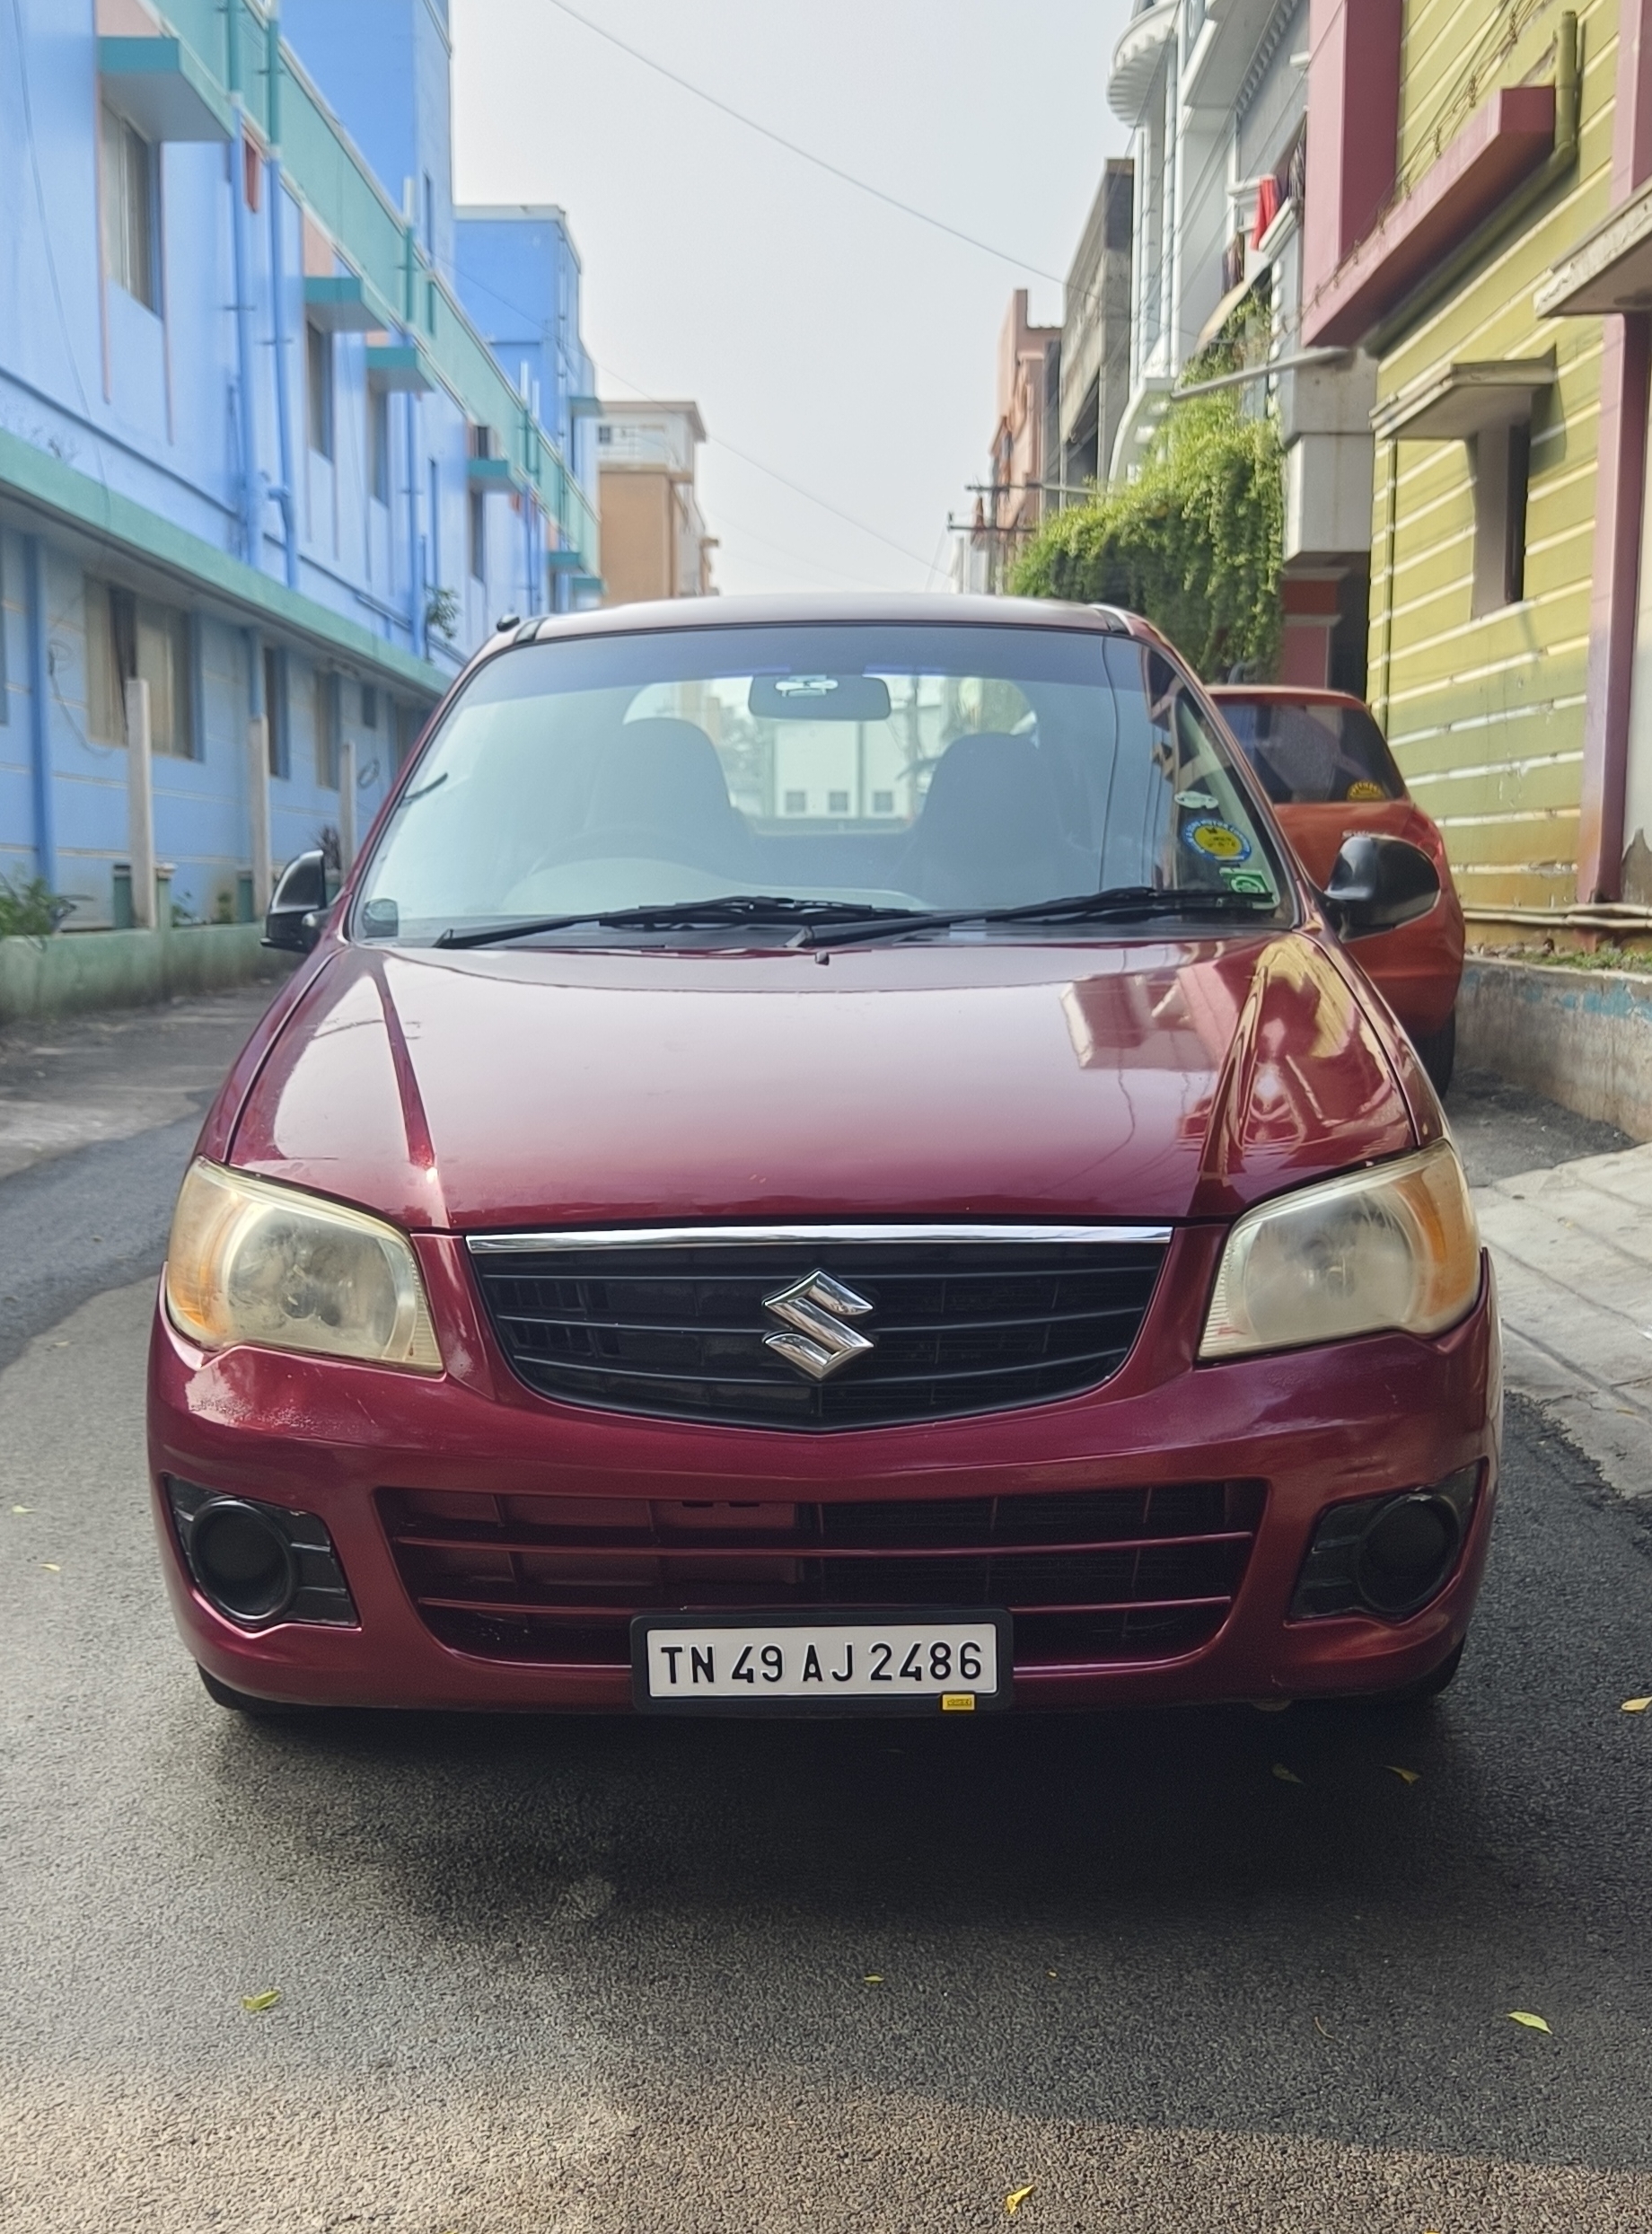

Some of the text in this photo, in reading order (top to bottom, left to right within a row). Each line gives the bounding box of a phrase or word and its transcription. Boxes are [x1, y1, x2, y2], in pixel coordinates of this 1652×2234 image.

[660, 1641, 982, 1684] TN 49 AJ 2486
